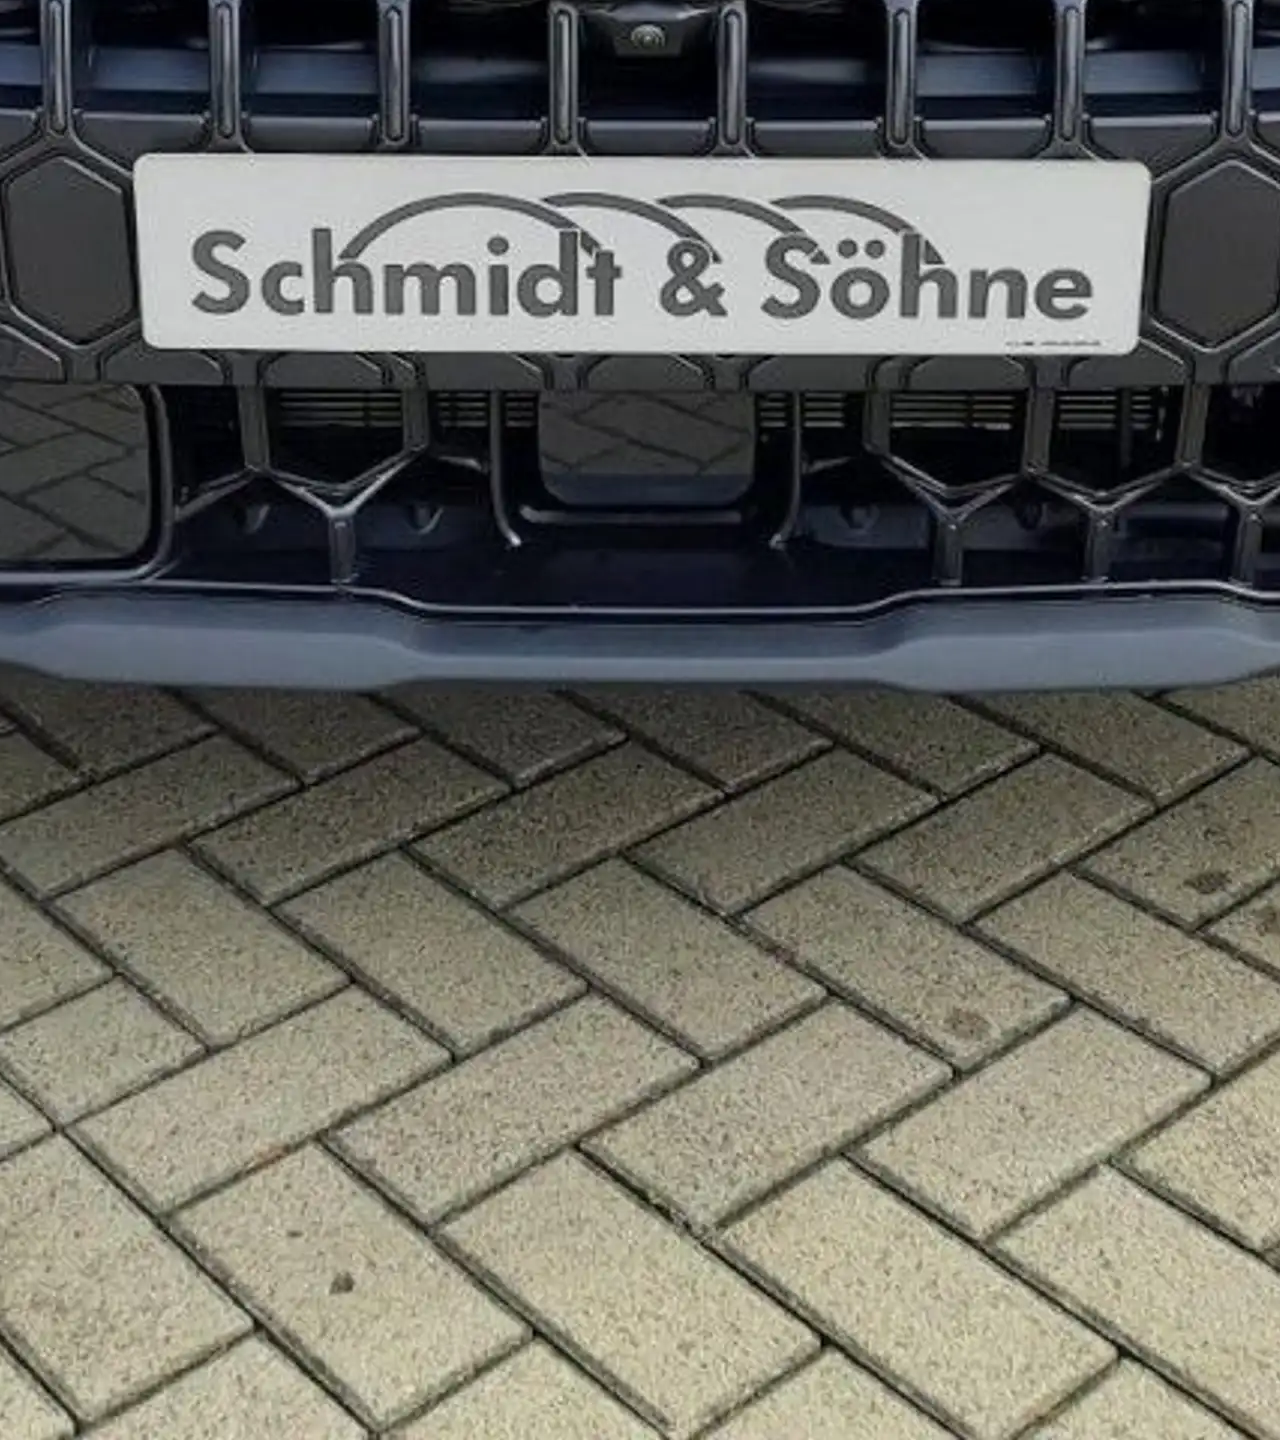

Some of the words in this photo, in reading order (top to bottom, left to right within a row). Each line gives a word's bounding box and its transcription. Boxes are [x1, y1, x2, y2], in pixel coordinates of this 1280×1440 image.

[191, 227, 622, 317] Schmidt
[660, 241, 728, 317] &
[760, 234, 1093, 320] Söhne
